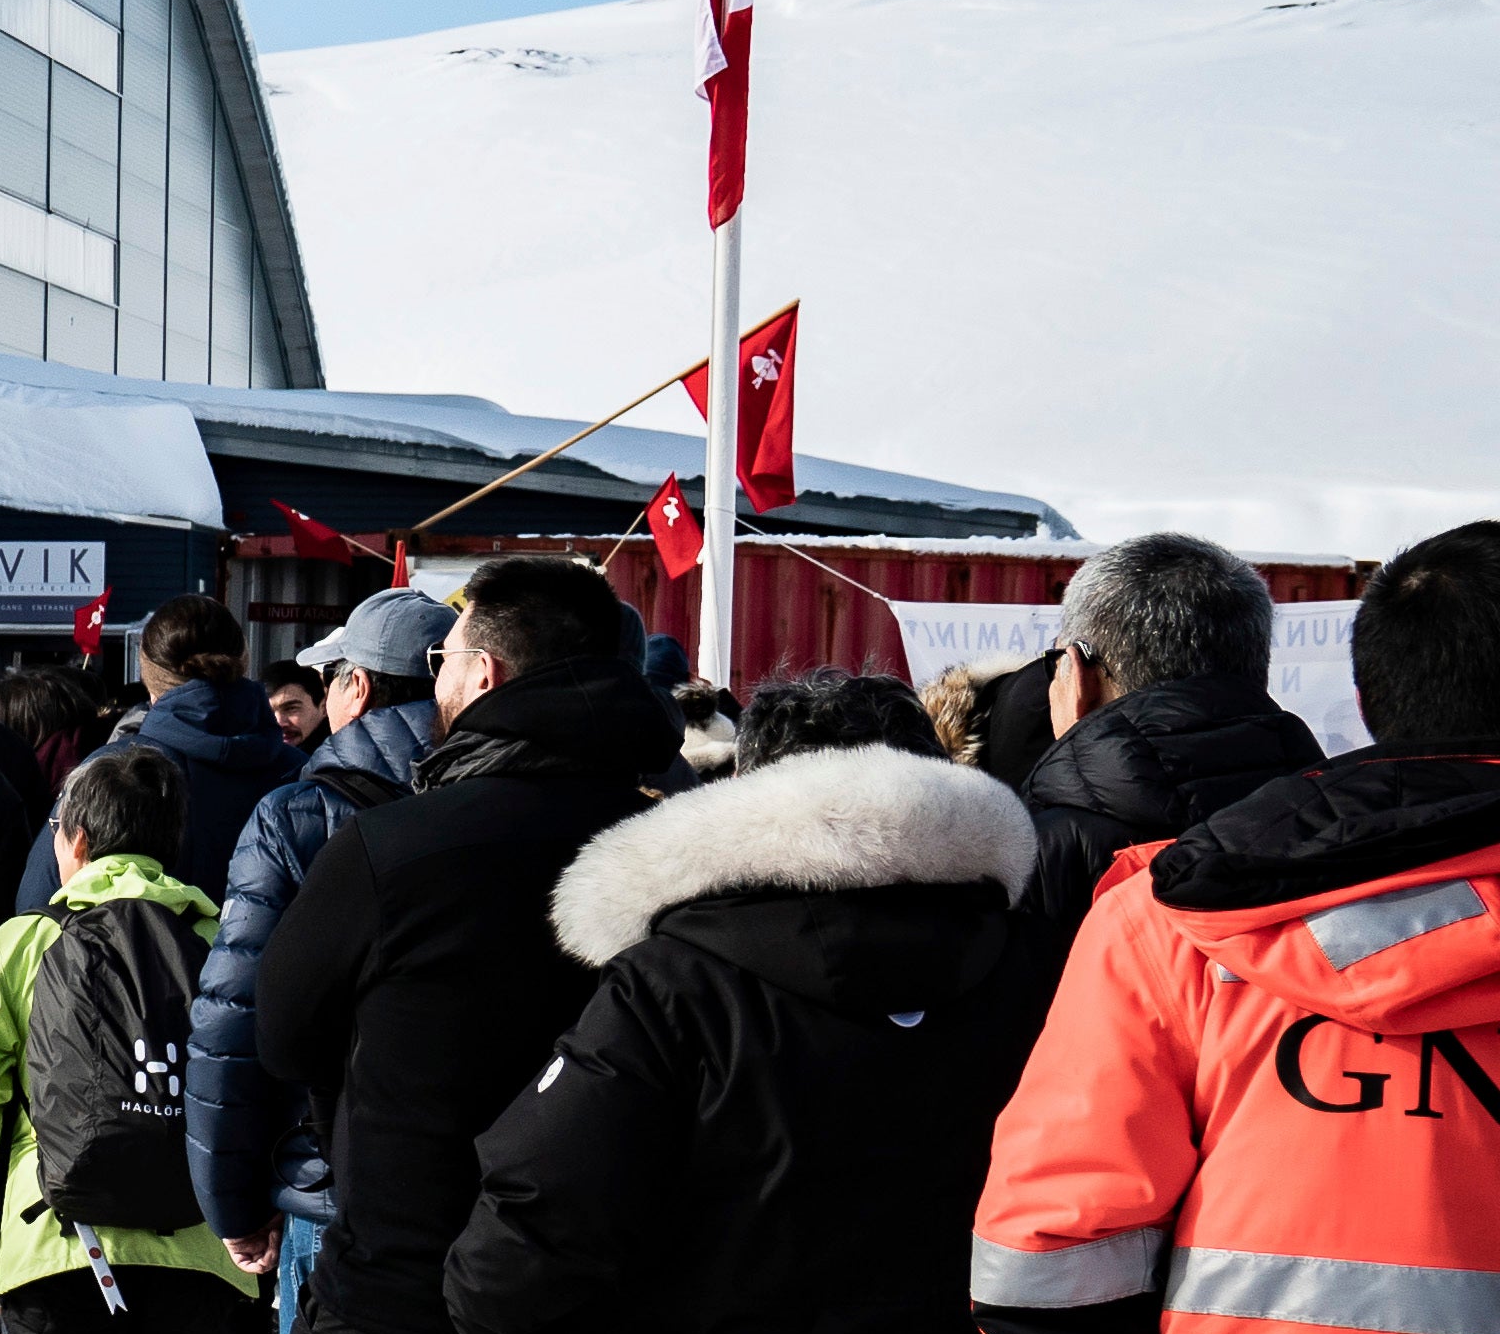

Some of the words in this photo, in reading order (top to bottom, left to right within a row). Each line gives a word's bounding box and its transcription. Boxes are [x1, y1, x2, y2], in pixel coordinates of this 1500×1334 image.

[268, 606, 301, 619] INUIT
[303, 608, 348, 620] ATAQA
[121, 1100, 183, 1117] HAGLÖF
